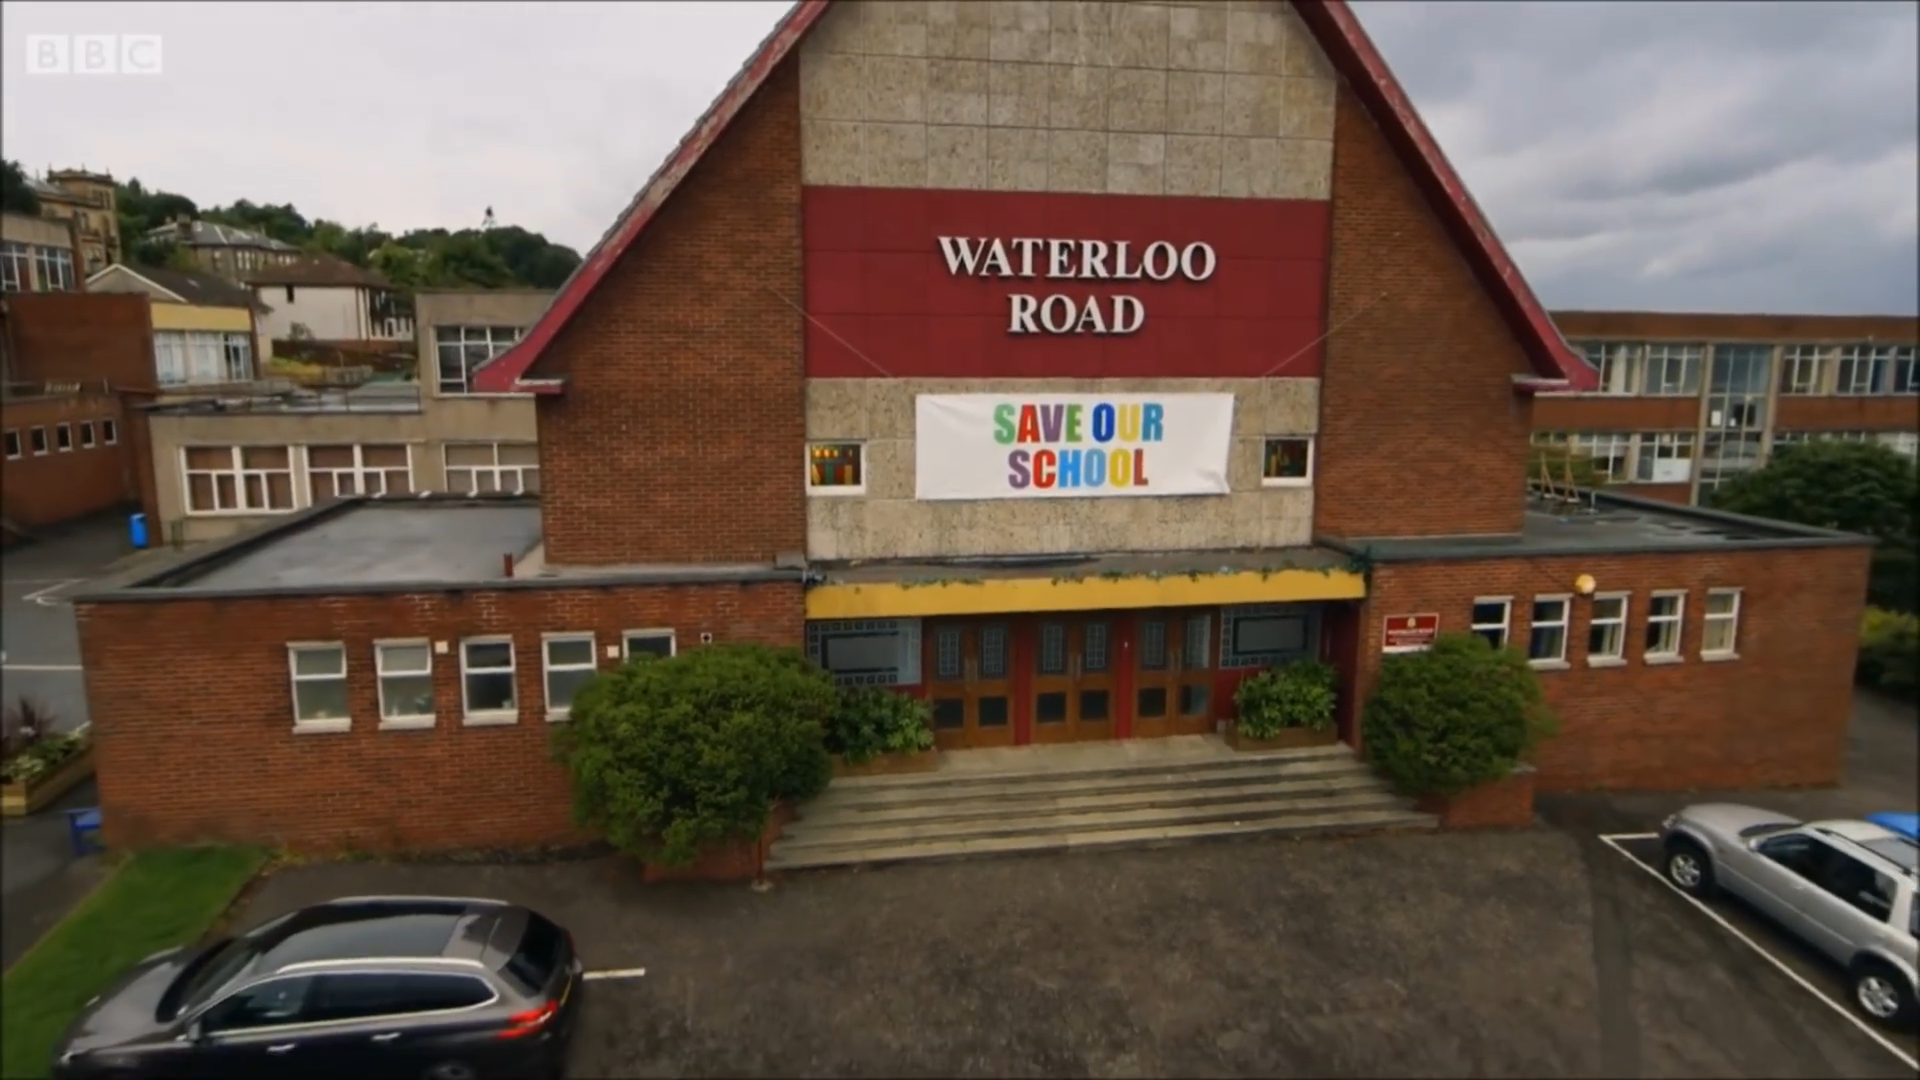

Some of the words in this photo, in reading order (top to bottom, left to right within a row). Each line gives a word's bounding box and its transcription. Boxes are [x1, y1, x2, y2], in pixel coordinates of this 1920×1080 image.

[937, 235, 1217, 281] WATERLOO
[1007, 293, 1145, 334] ROAD
[992, 402, 1083, 444] SAVE
[1091, 402, 1164, 443] OUR
[1007, 448, 1149, 489] SCHOOL
